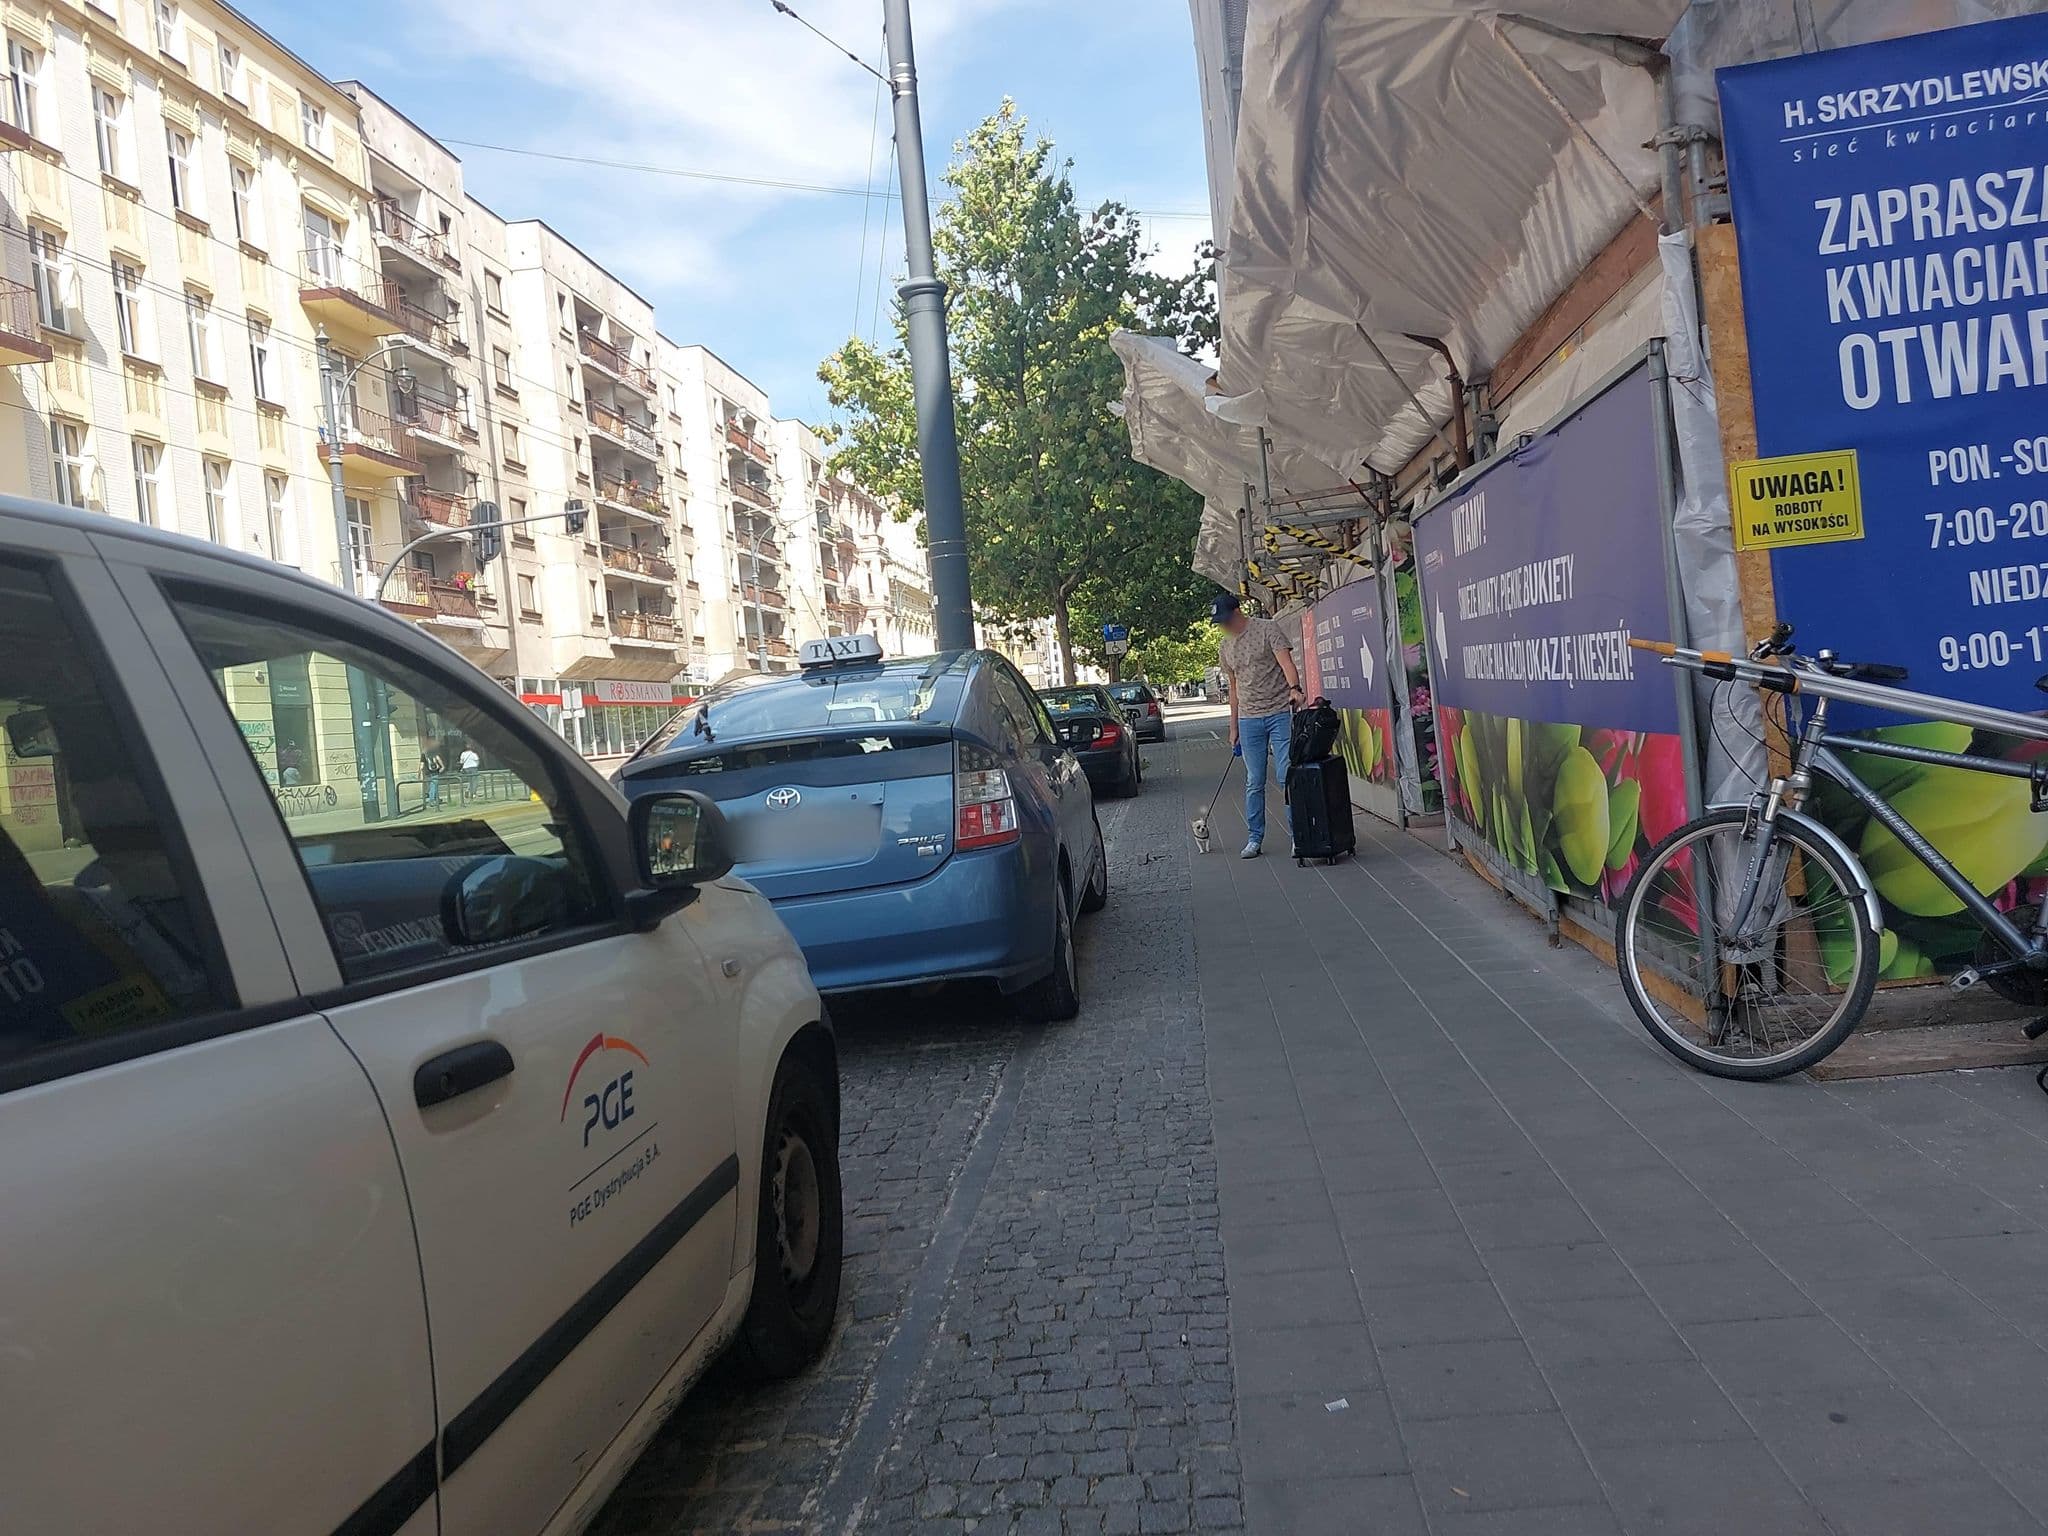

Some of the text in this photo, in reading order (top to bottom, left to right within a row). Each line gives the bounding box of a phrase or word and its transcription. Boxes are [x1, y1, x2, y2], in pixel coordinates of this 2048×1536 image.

[1784, 59, 2048, 129] H. SKRZYDLEWSK
[1793, 111, 2048, 163] sieć kwiaciar
[1815, 164, 2048, 255] ZAPRASZ
[1451, 491, 1487, 558] WITAMY!
[1752, 523, 1770, 537] NA
[1775, 499, 1823, 517] ROBOTY
[1523, 553, 1575, 607] BUKIETY
[809, 639, 864, 659] TAXI
[1526, 635, 1574, 689] OKAZJĘ
[1578, 618, 1634, 681] KIESZEŃ!
[610, 682, 664, 700] ROSSMANN
[896, 833, 946, 845] PRIUS
[584, 1070, 635, 1148] PGE
[569, 1195, 592, 1228] PGE
[594, 1157, 645, 1208] Dystrybucja
